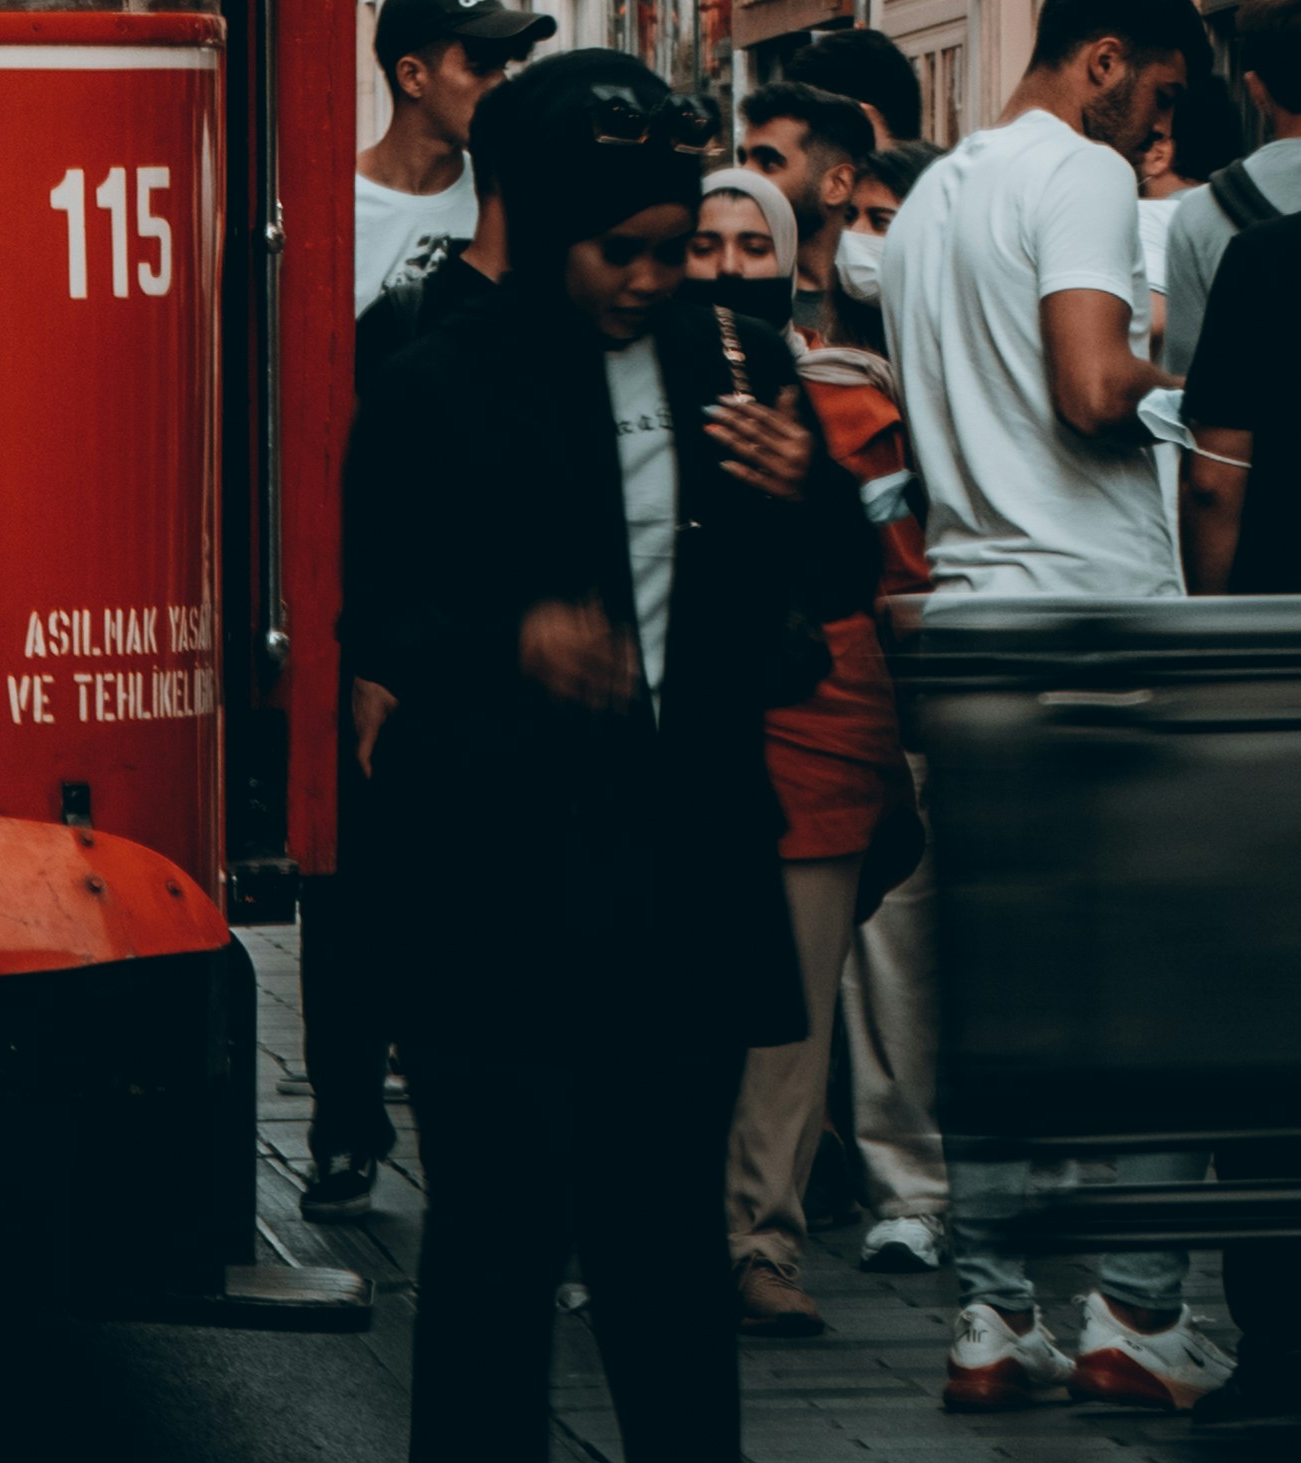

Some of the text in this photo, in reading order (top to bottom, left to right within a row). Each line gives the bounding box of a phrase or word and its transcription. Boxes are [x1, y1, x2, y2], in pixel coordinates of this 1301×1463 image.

[49, 166, 173, 299] 115
[24, 606, 158, 658] ASILMAK
[6, 674, 55, 725] VE
